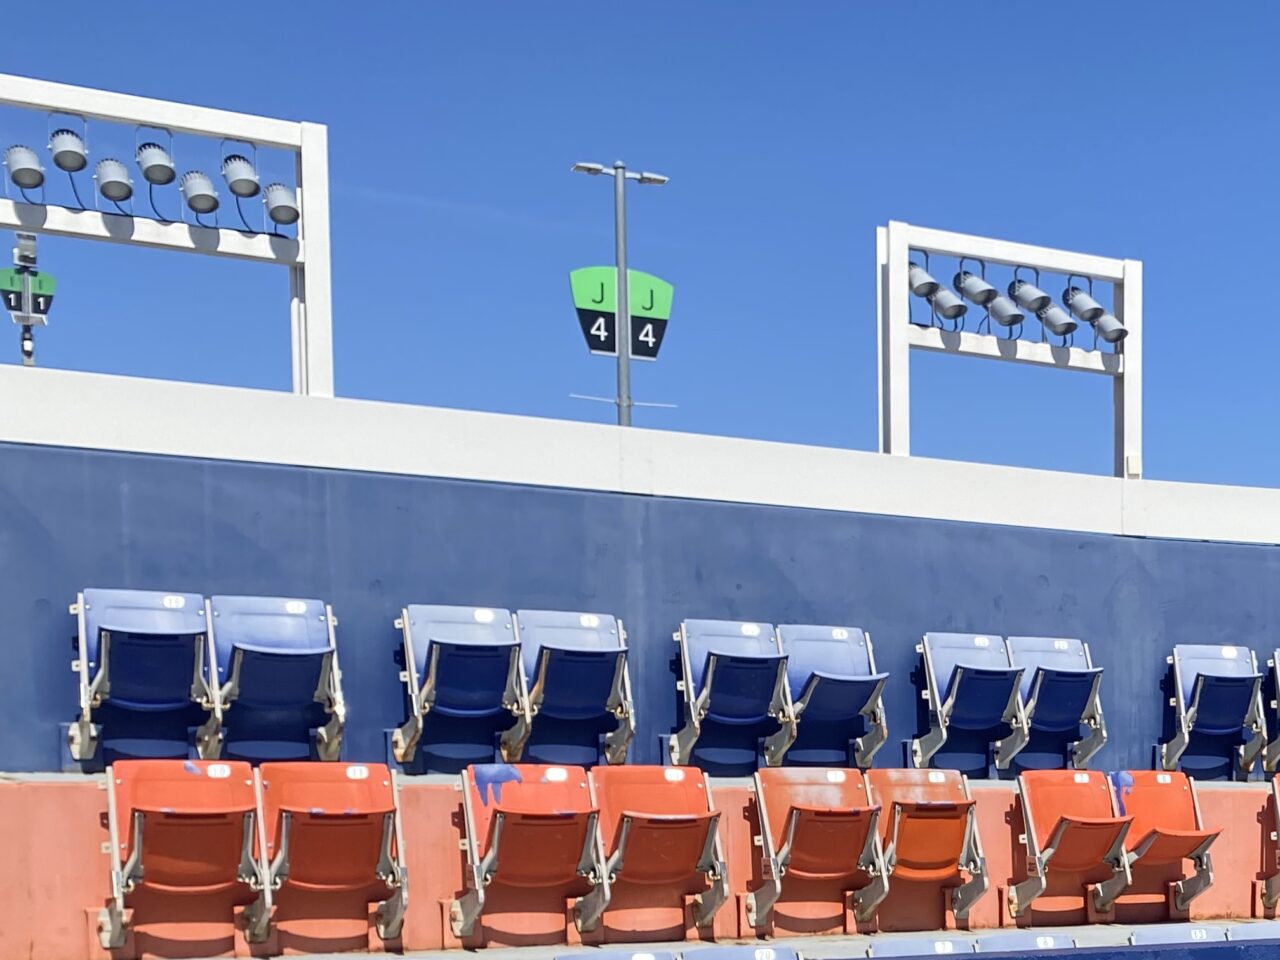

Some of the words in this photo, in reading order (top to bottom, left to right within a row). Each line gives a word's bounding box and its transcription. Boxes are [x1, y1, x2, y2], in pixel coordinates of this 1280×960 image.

[8, 292, 17, 307] 1
[37, 296, 46, 311] 1
[591, 281, 605, 305] J
[641, 288, 654, 312] J
[590, 316, 609, 342] 4
[638, 322, 656, 348] 4
